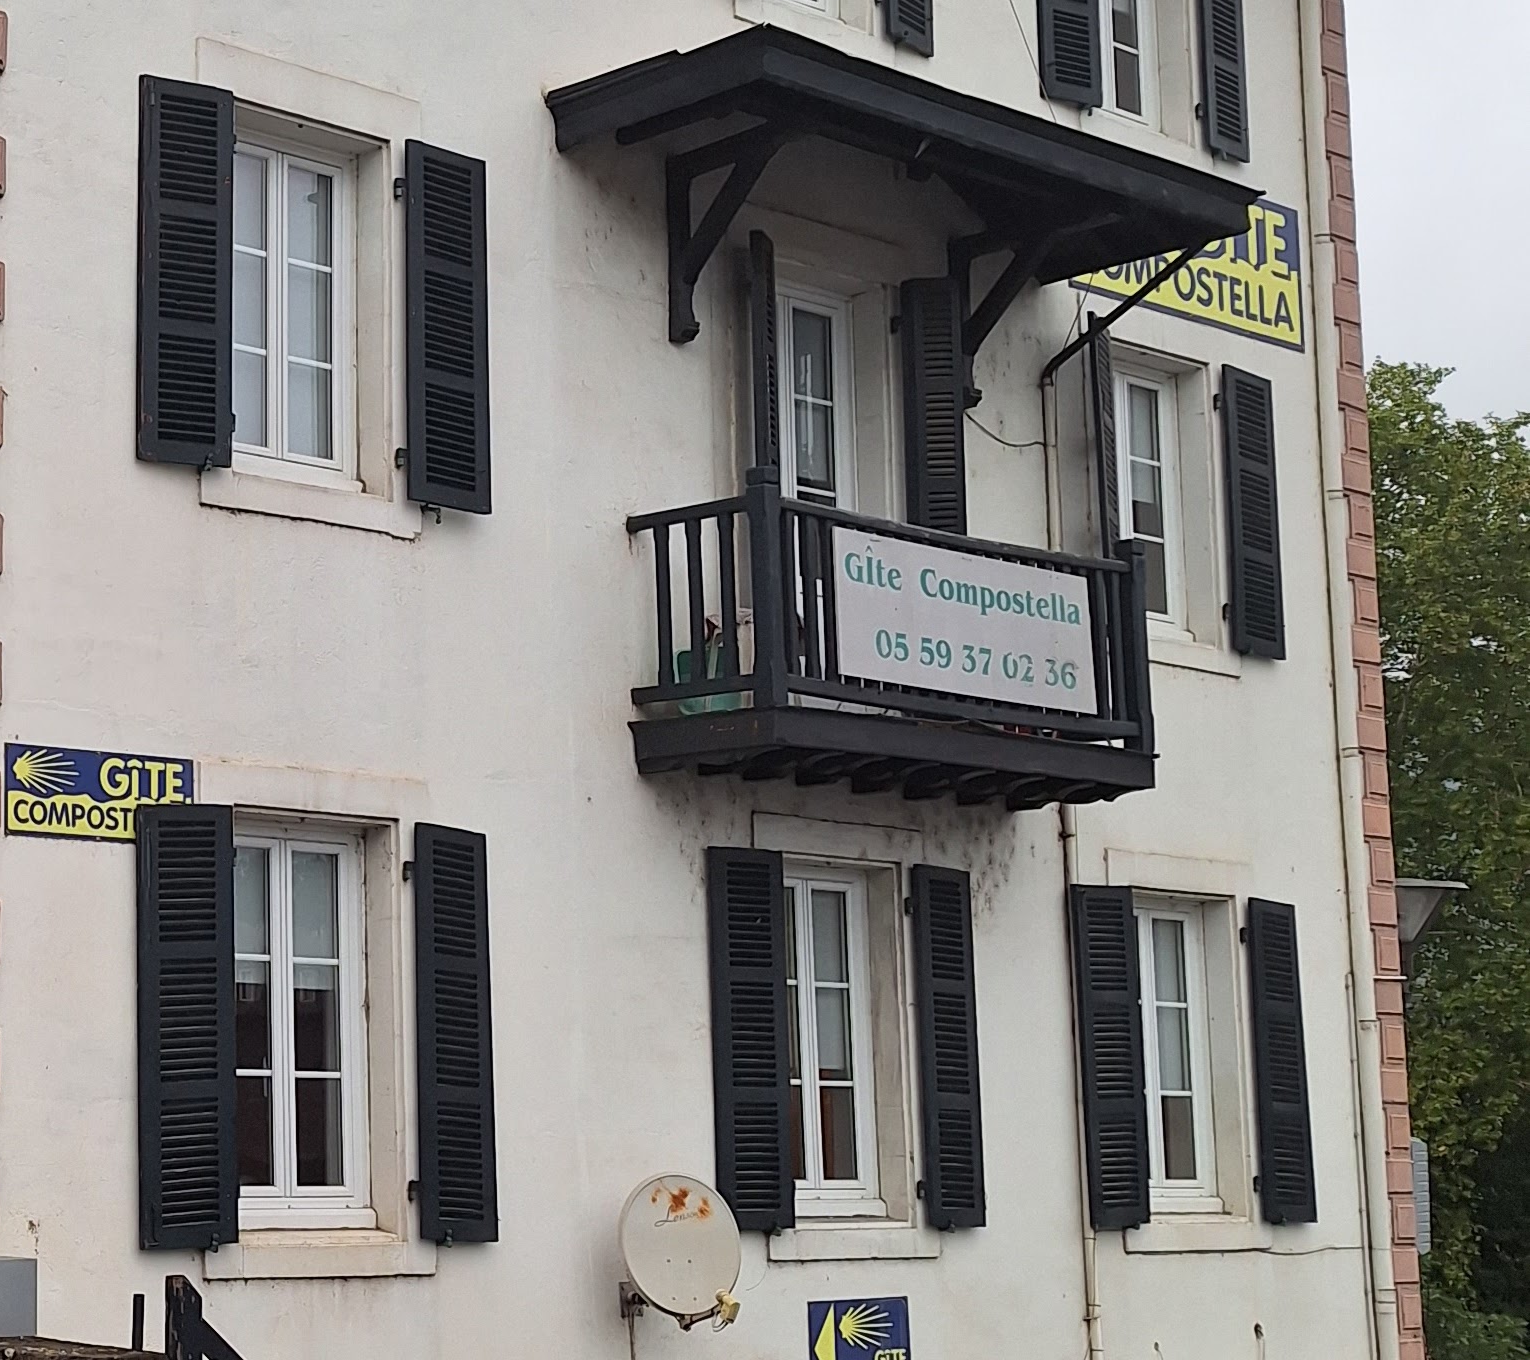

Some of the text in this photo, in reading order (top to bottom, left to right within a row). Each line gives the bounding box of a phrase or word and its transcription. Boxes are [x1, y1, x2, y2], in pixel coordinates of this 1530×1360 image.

[919, 568, 1081, 626] Compostella
[875, 629, 1077, 690] 05 59 37 02 36
[13, 799, 134, 832] COMPOST
